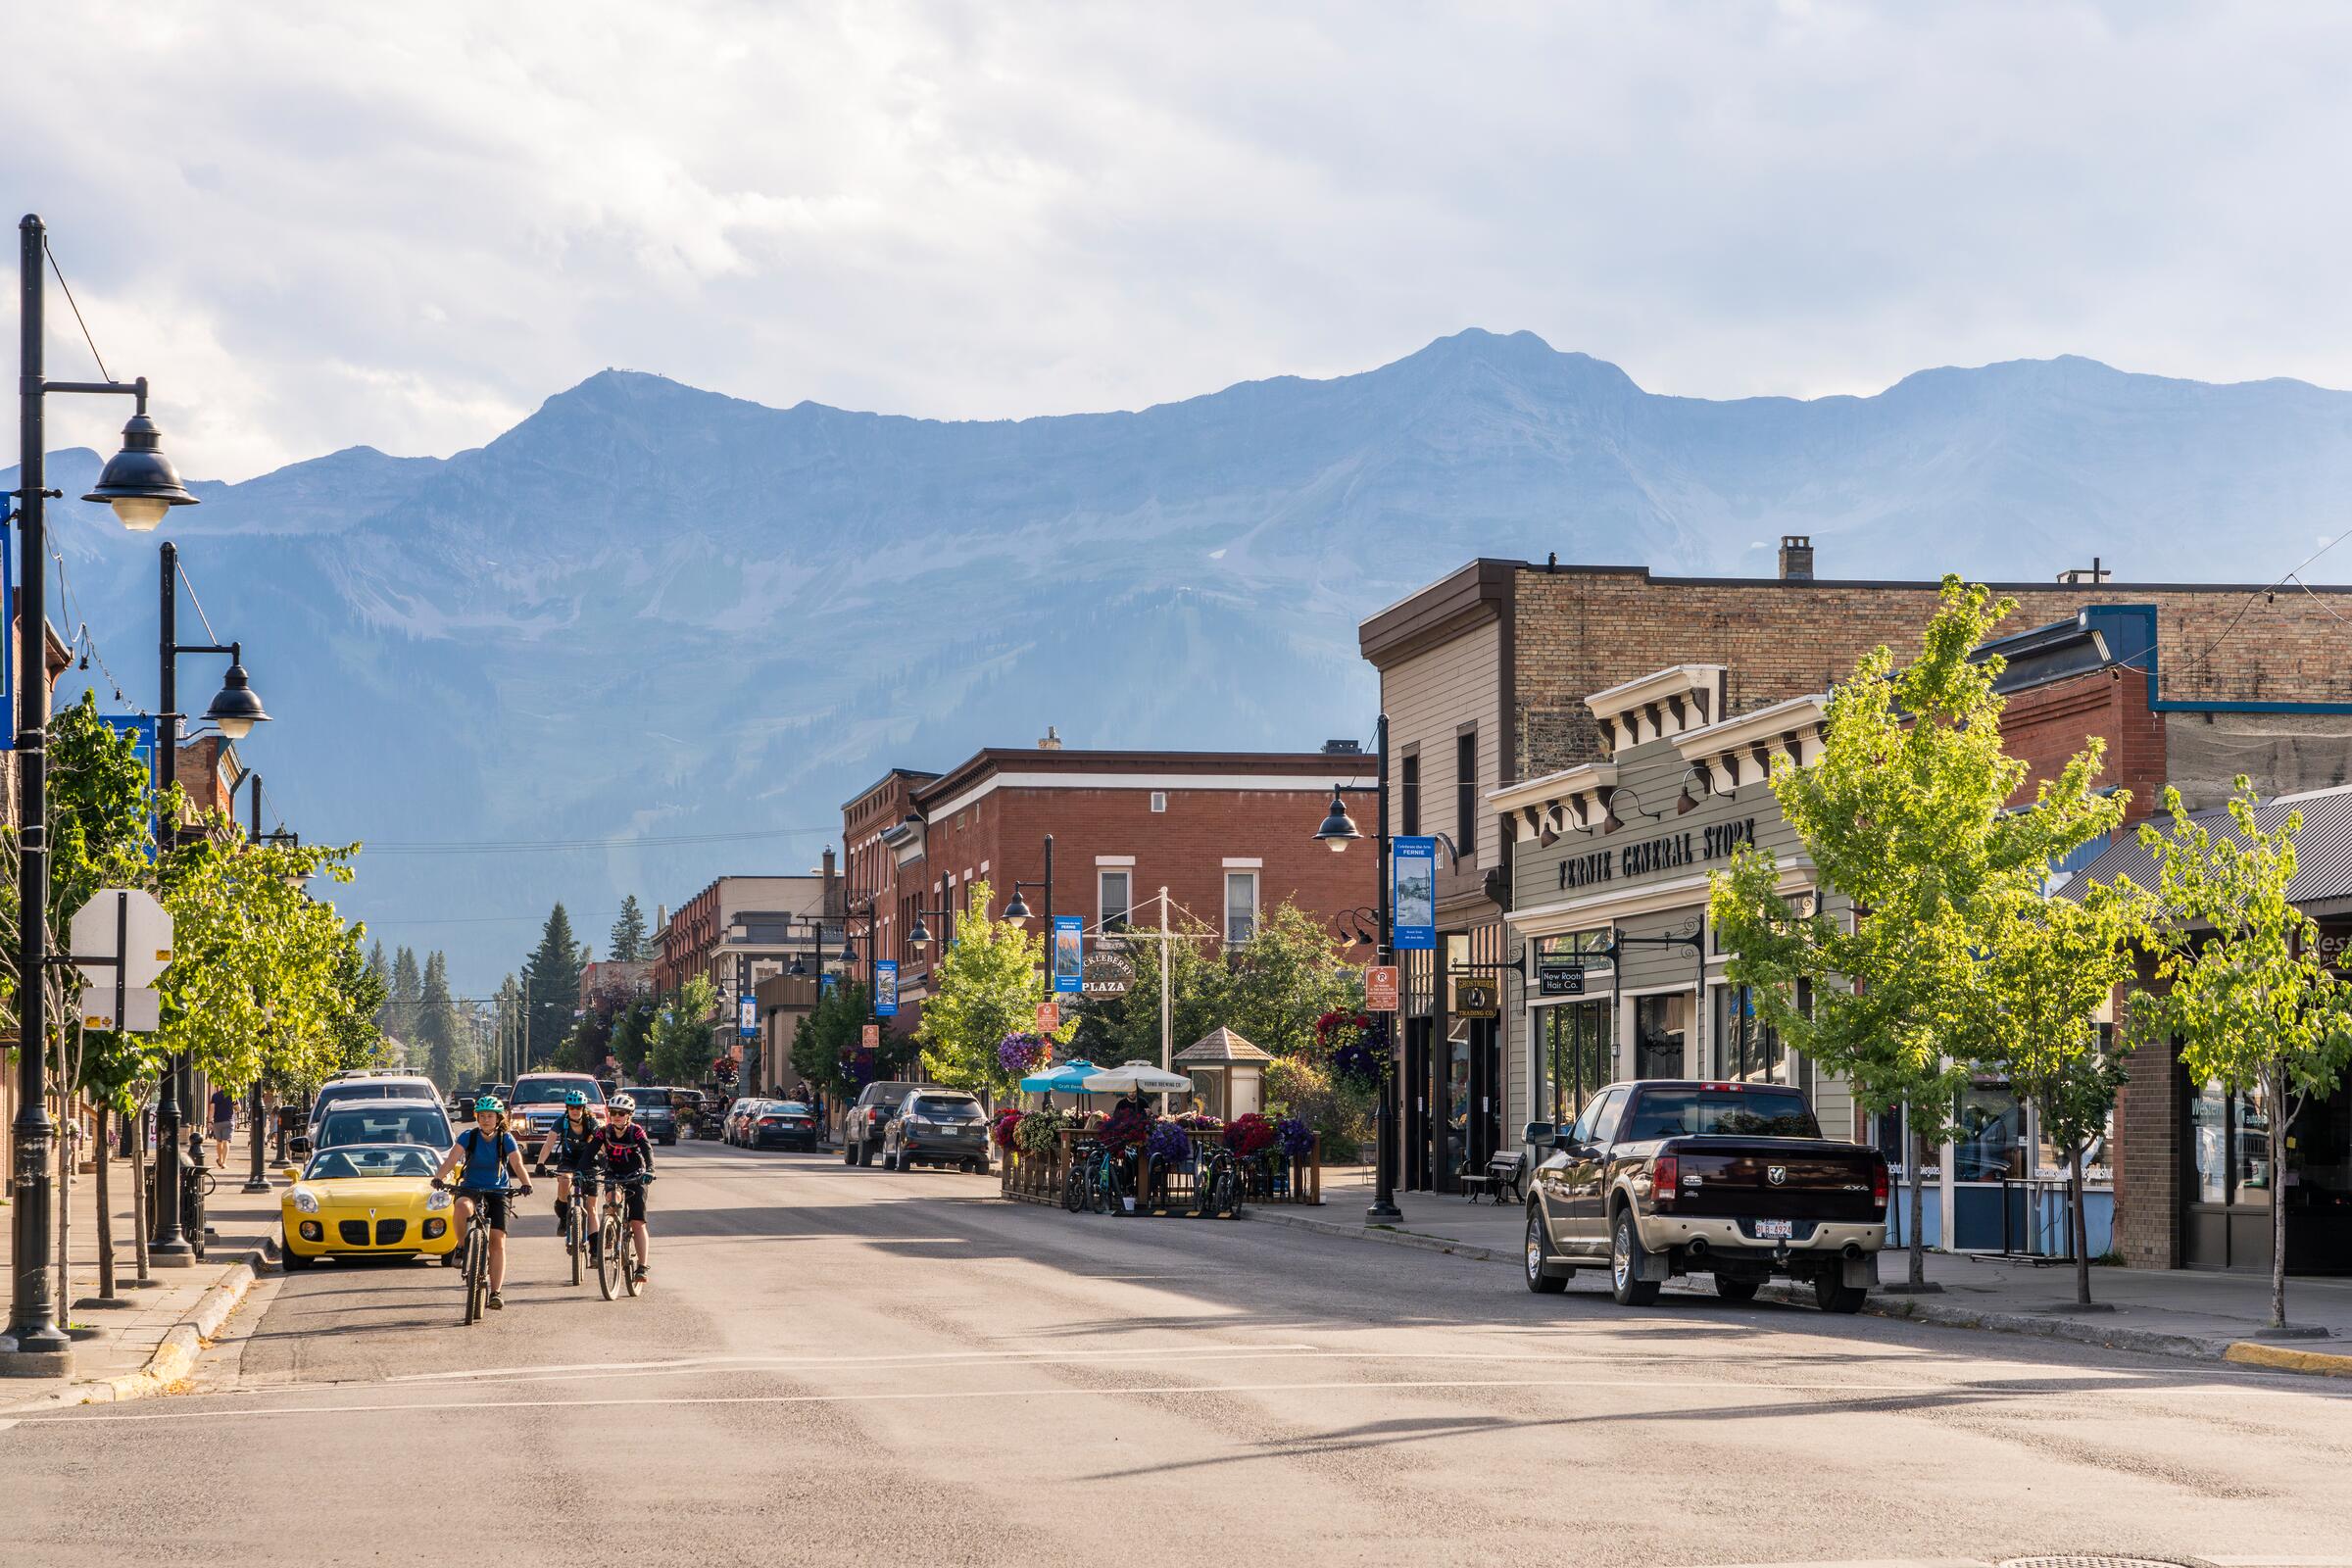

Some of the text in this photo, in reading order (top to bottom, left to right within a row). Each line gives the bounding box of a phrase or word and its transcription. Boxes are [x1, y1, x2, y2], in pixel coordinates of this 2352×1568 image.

[1559, 817, 1755, 889] FERNIE GENERAL STORE
[1083, 955, 1134, 975] CKLEBERRY
[1561, 971, 1582, 980] Roots
[1082, 982, 1126, 992] PLAZA
[1457, 979, 1495, 989] GHOSTRIDER
[1546, 980, 1579, 989] Hair Co.
[2191, 1098, 2225, 1116] Western
